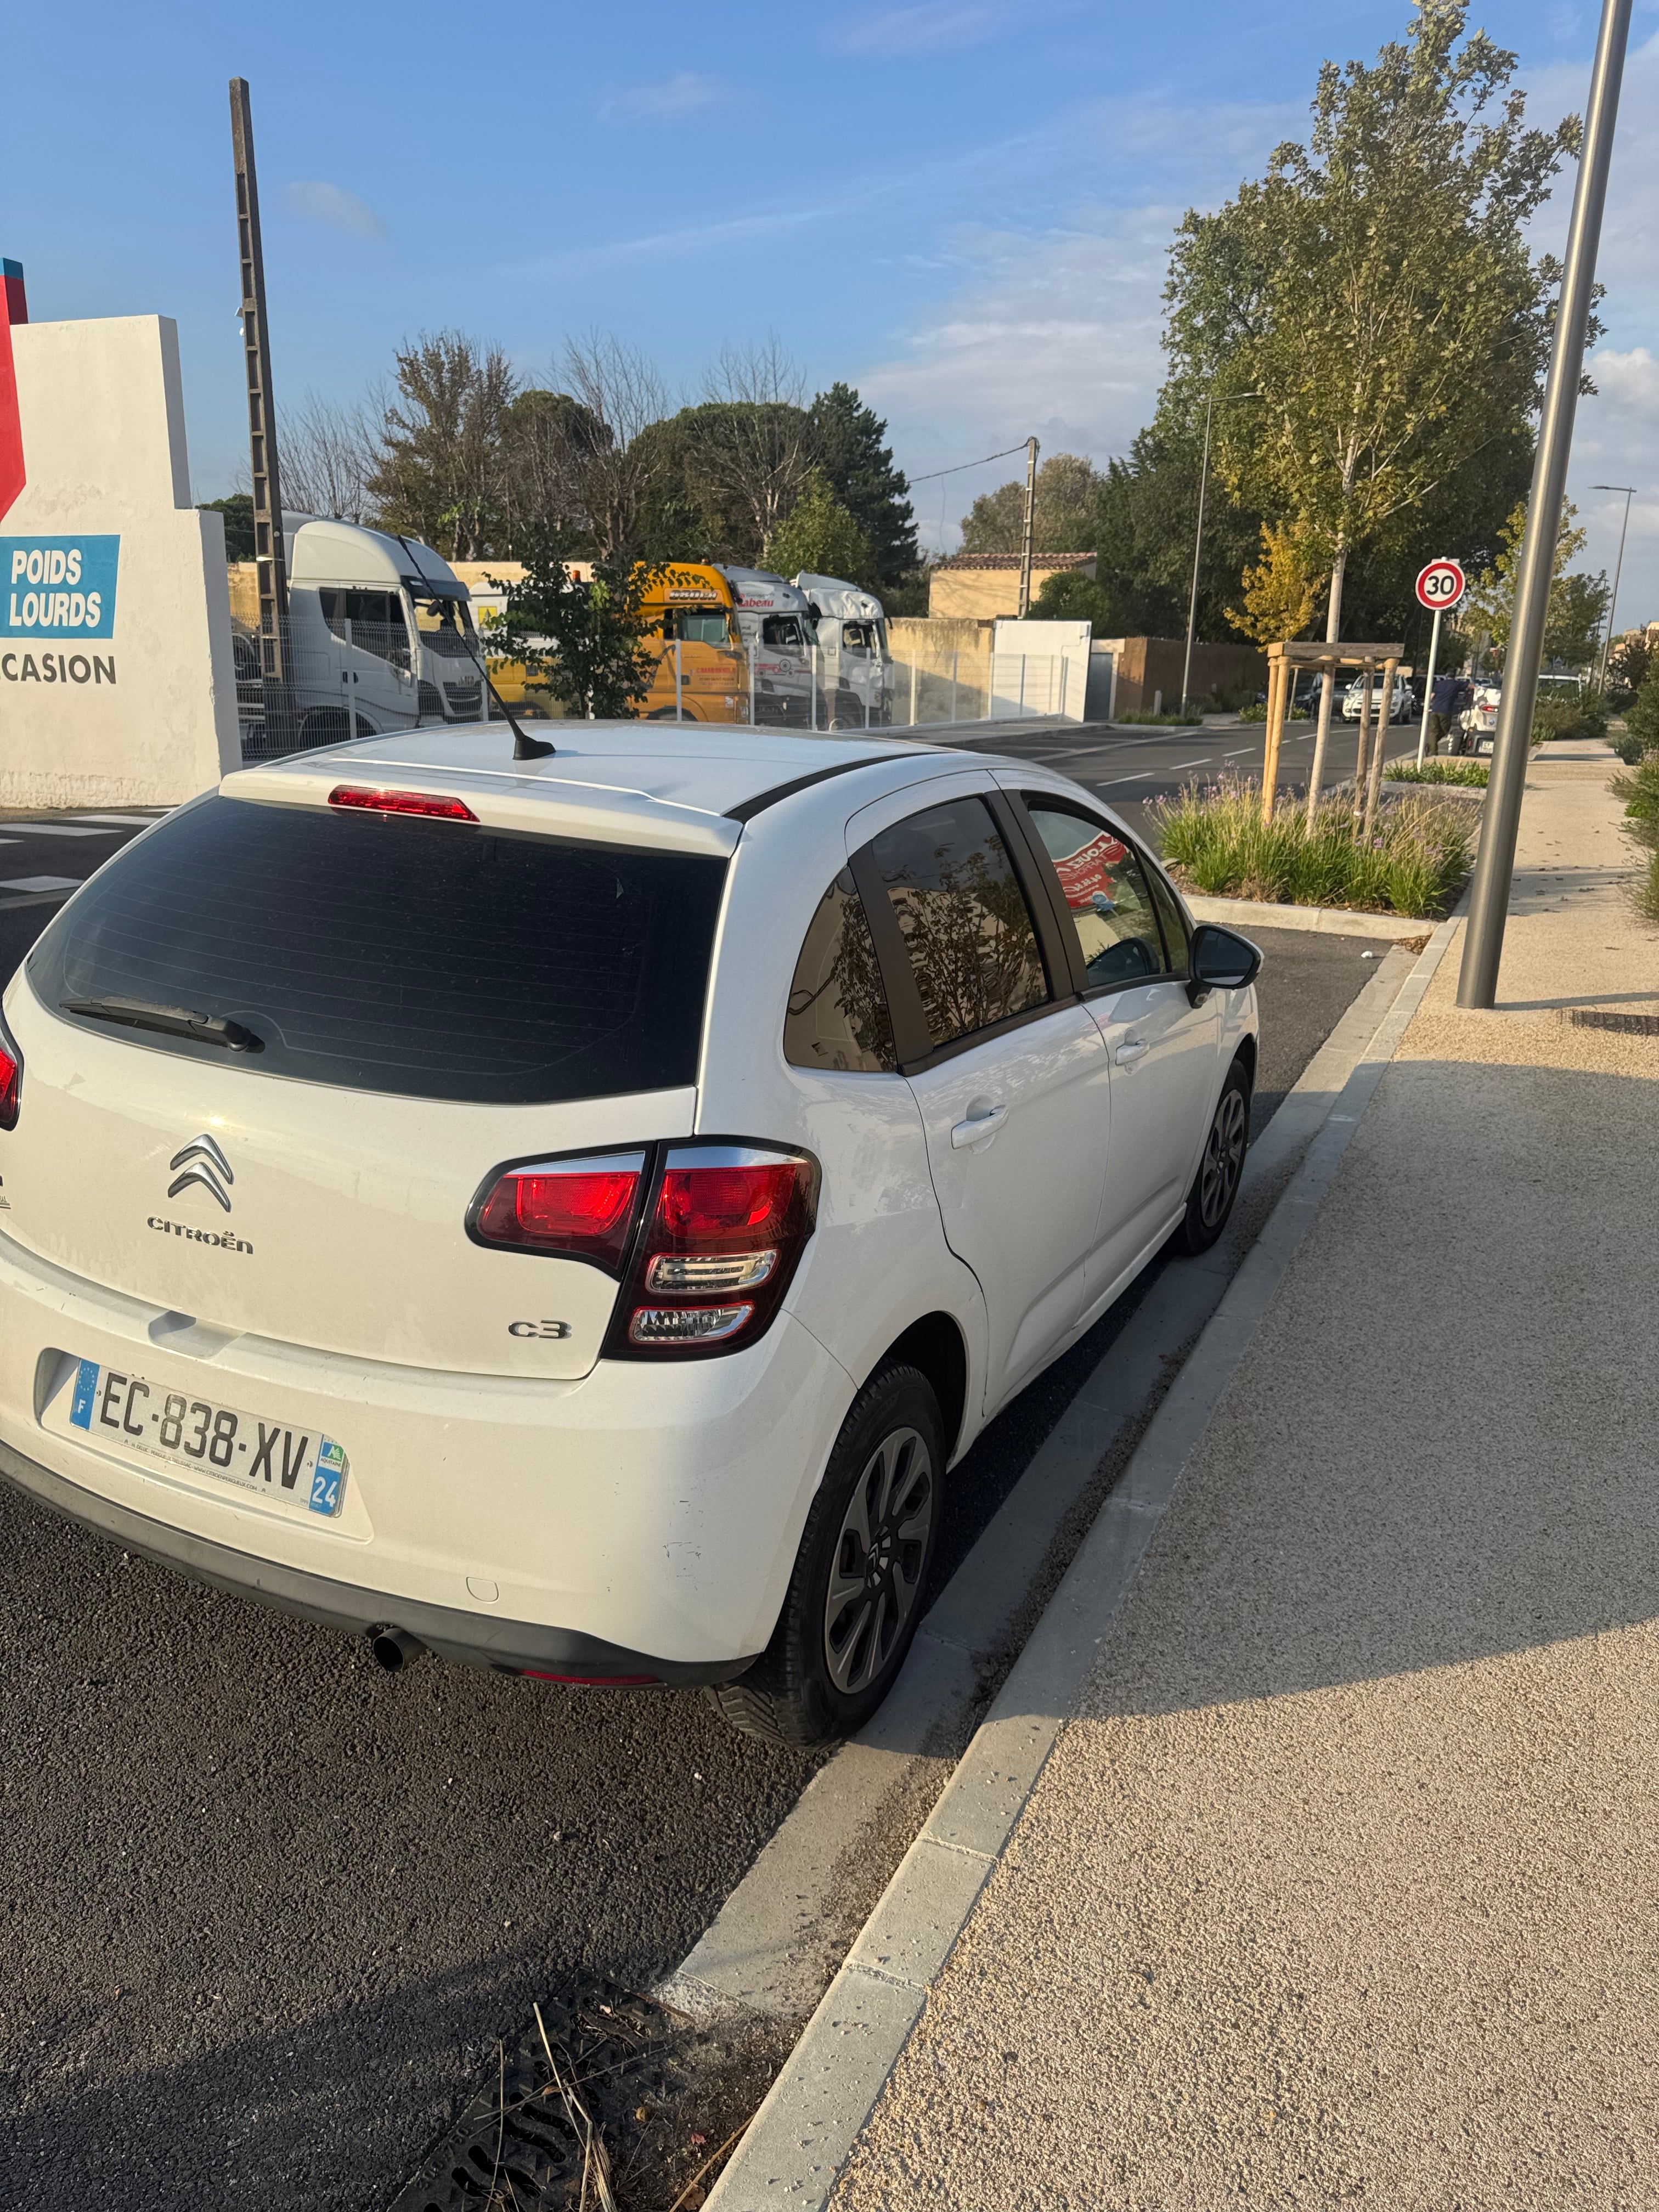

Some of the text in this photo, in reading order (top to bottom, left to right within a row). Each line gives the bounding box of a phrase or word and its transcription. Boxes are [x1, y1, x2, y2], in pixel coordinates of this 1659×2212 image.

[11, 549, 82, 585] POIDS
[1426, 575, 1454, 595] 30
[9, 591, 101, 628] LOURDS
[0, 653, 117, 685] CASION
[508, 1319, 572, 1339] C3
[77, 1400, 86, 1414] F
[100, 1372, 309, 1490] EC-838-XV
[320, 1457, 341, 1468] AQUITAINE
[312, 1476, 336, 1508] 24
